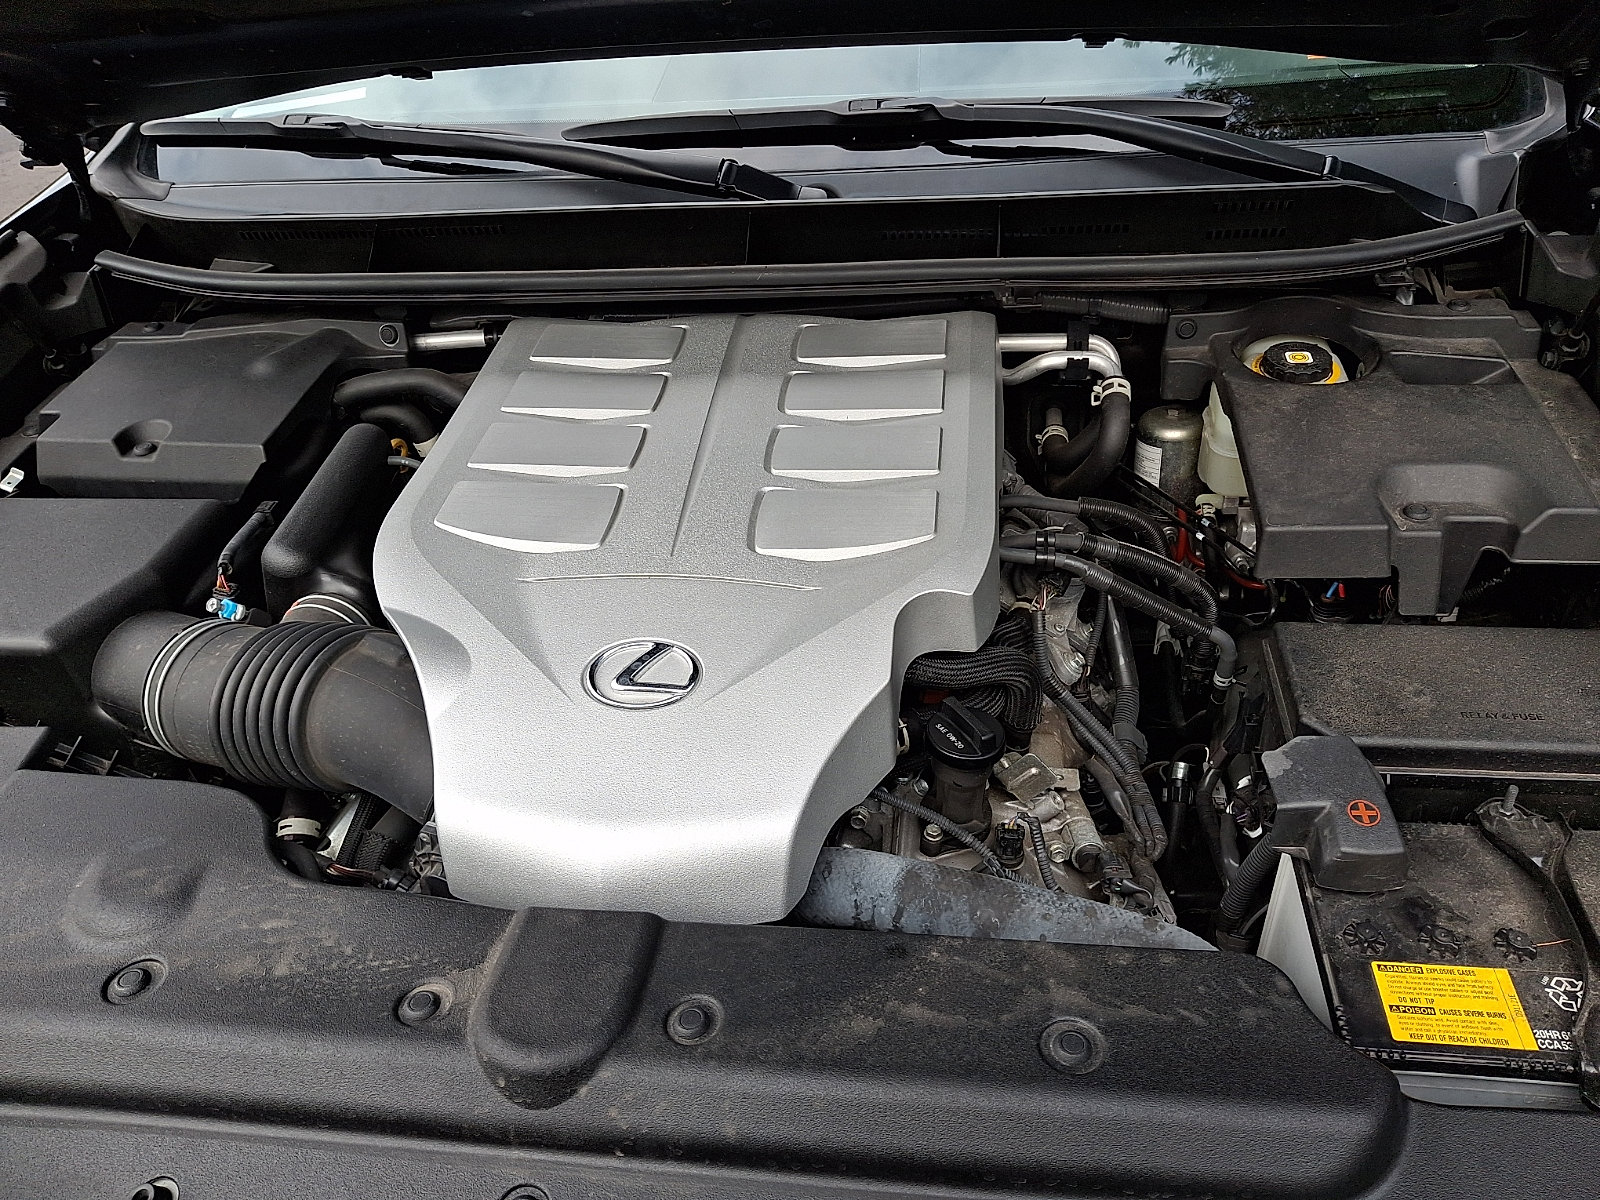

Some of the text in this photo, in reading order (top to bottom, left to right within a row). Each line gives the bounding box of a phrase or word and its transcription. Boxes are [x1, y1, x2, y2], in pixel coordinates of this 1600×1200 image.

[1460, 711, 1498, 719] RELAY
[1501, 712, 1510, 720] &
[935, 723, 948, 734] SAE
[1386, 965, 1477, 977] DANGER EXPLOSIVE GASES
[1425, 997, 1435, 1005] TIP
[1398, 1006, 1507, 1019] POISON CAUSES SEVERE BURNS
[1409, 1032, 1510, 1046] KEEP OUT OF REACH OF CHILDREN
